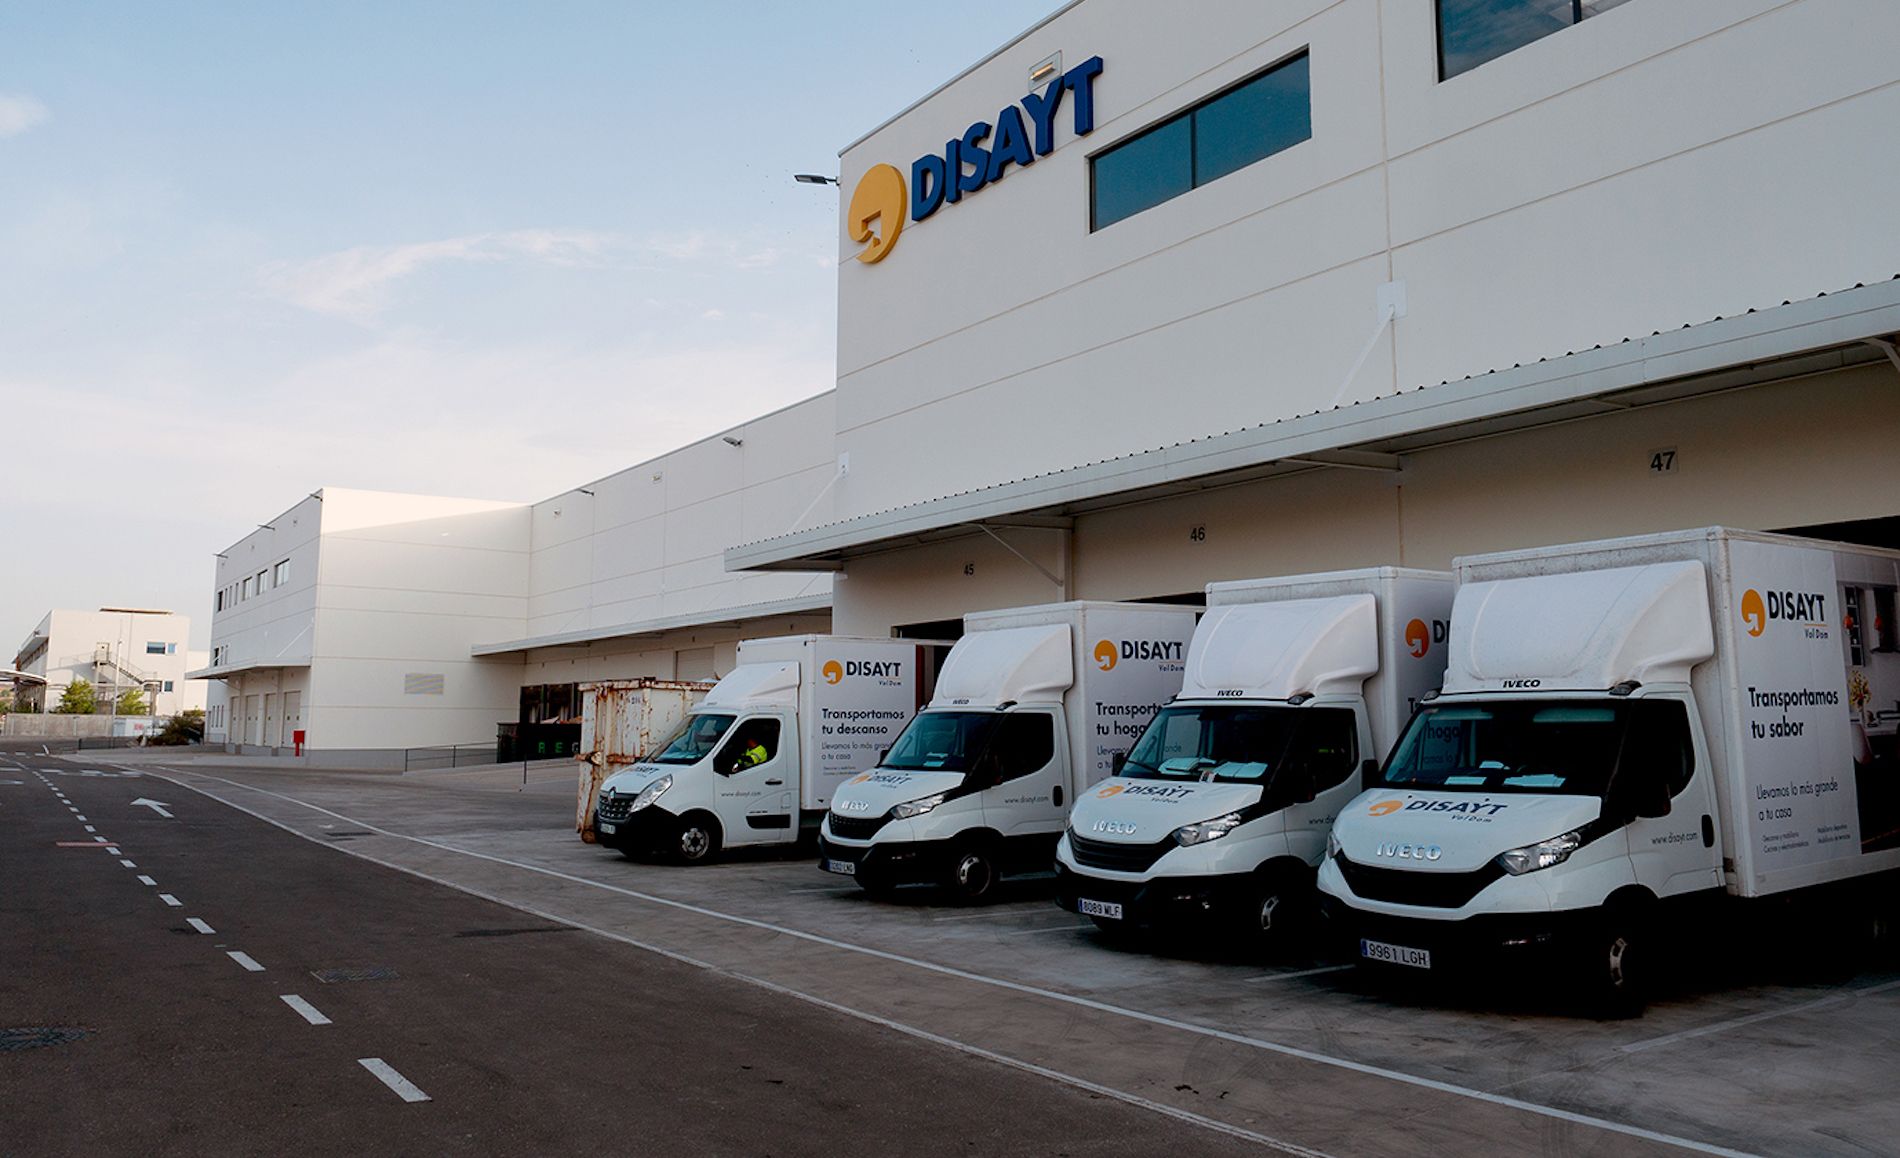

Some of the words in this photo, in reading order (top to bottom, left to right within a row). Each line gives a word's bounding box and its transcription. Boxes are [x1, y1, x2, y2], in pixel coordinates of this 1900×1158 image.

[911, 55, 1104, 222] DISAYT
[1651, 451, 1675, 471] 47
[1190, 526, 1205, 541] 46
[964, 563, 974, 576] 45
[1767, 590, 1825, 622] DISAYT
[1121, 640, 1183, 660] DISAYT
[846, 661, 901, 677] DISAYT
[1502, 679, 1541, 689] IVECO
[1217, 689, 1243, 697] IVECO
[1748, 687, 1839, 712] Transportamos
[822, 708, 905, 722] Transportamos
[1096, 702, 1158, 719] Transport
[822, 725, 833, 735] tu
[837, 723, 888, 735] descanso
[1097, 723, 1109, 735] tu
[1114, 720, 1148, 739] hoga
[1427, 722, 1460, 743] hoga
[1751, 719, 1765, 739] tu
[1770, 715, 1804, 738] sabor
[822, 742, 850, 751] Llevamos
[852, 742, 858, 750] lo
[1124, 786, 1195, 798] DISAYT
[1756, 783, 1790, 800] Llevamos
[1790, 781, 1798, 796] lo
[1815, 777, 1838, 797] grande
[1405, 800, 1508, 815] DISAYT
[1775, 807, 1792, 819] casa
[1093, 820, 1136, 835] IVECO
[1376, 842, 1442, 861] IVECO
[1368, 943, 1397, 961] 9961
[1402, 949, 1426, 966] LGH
